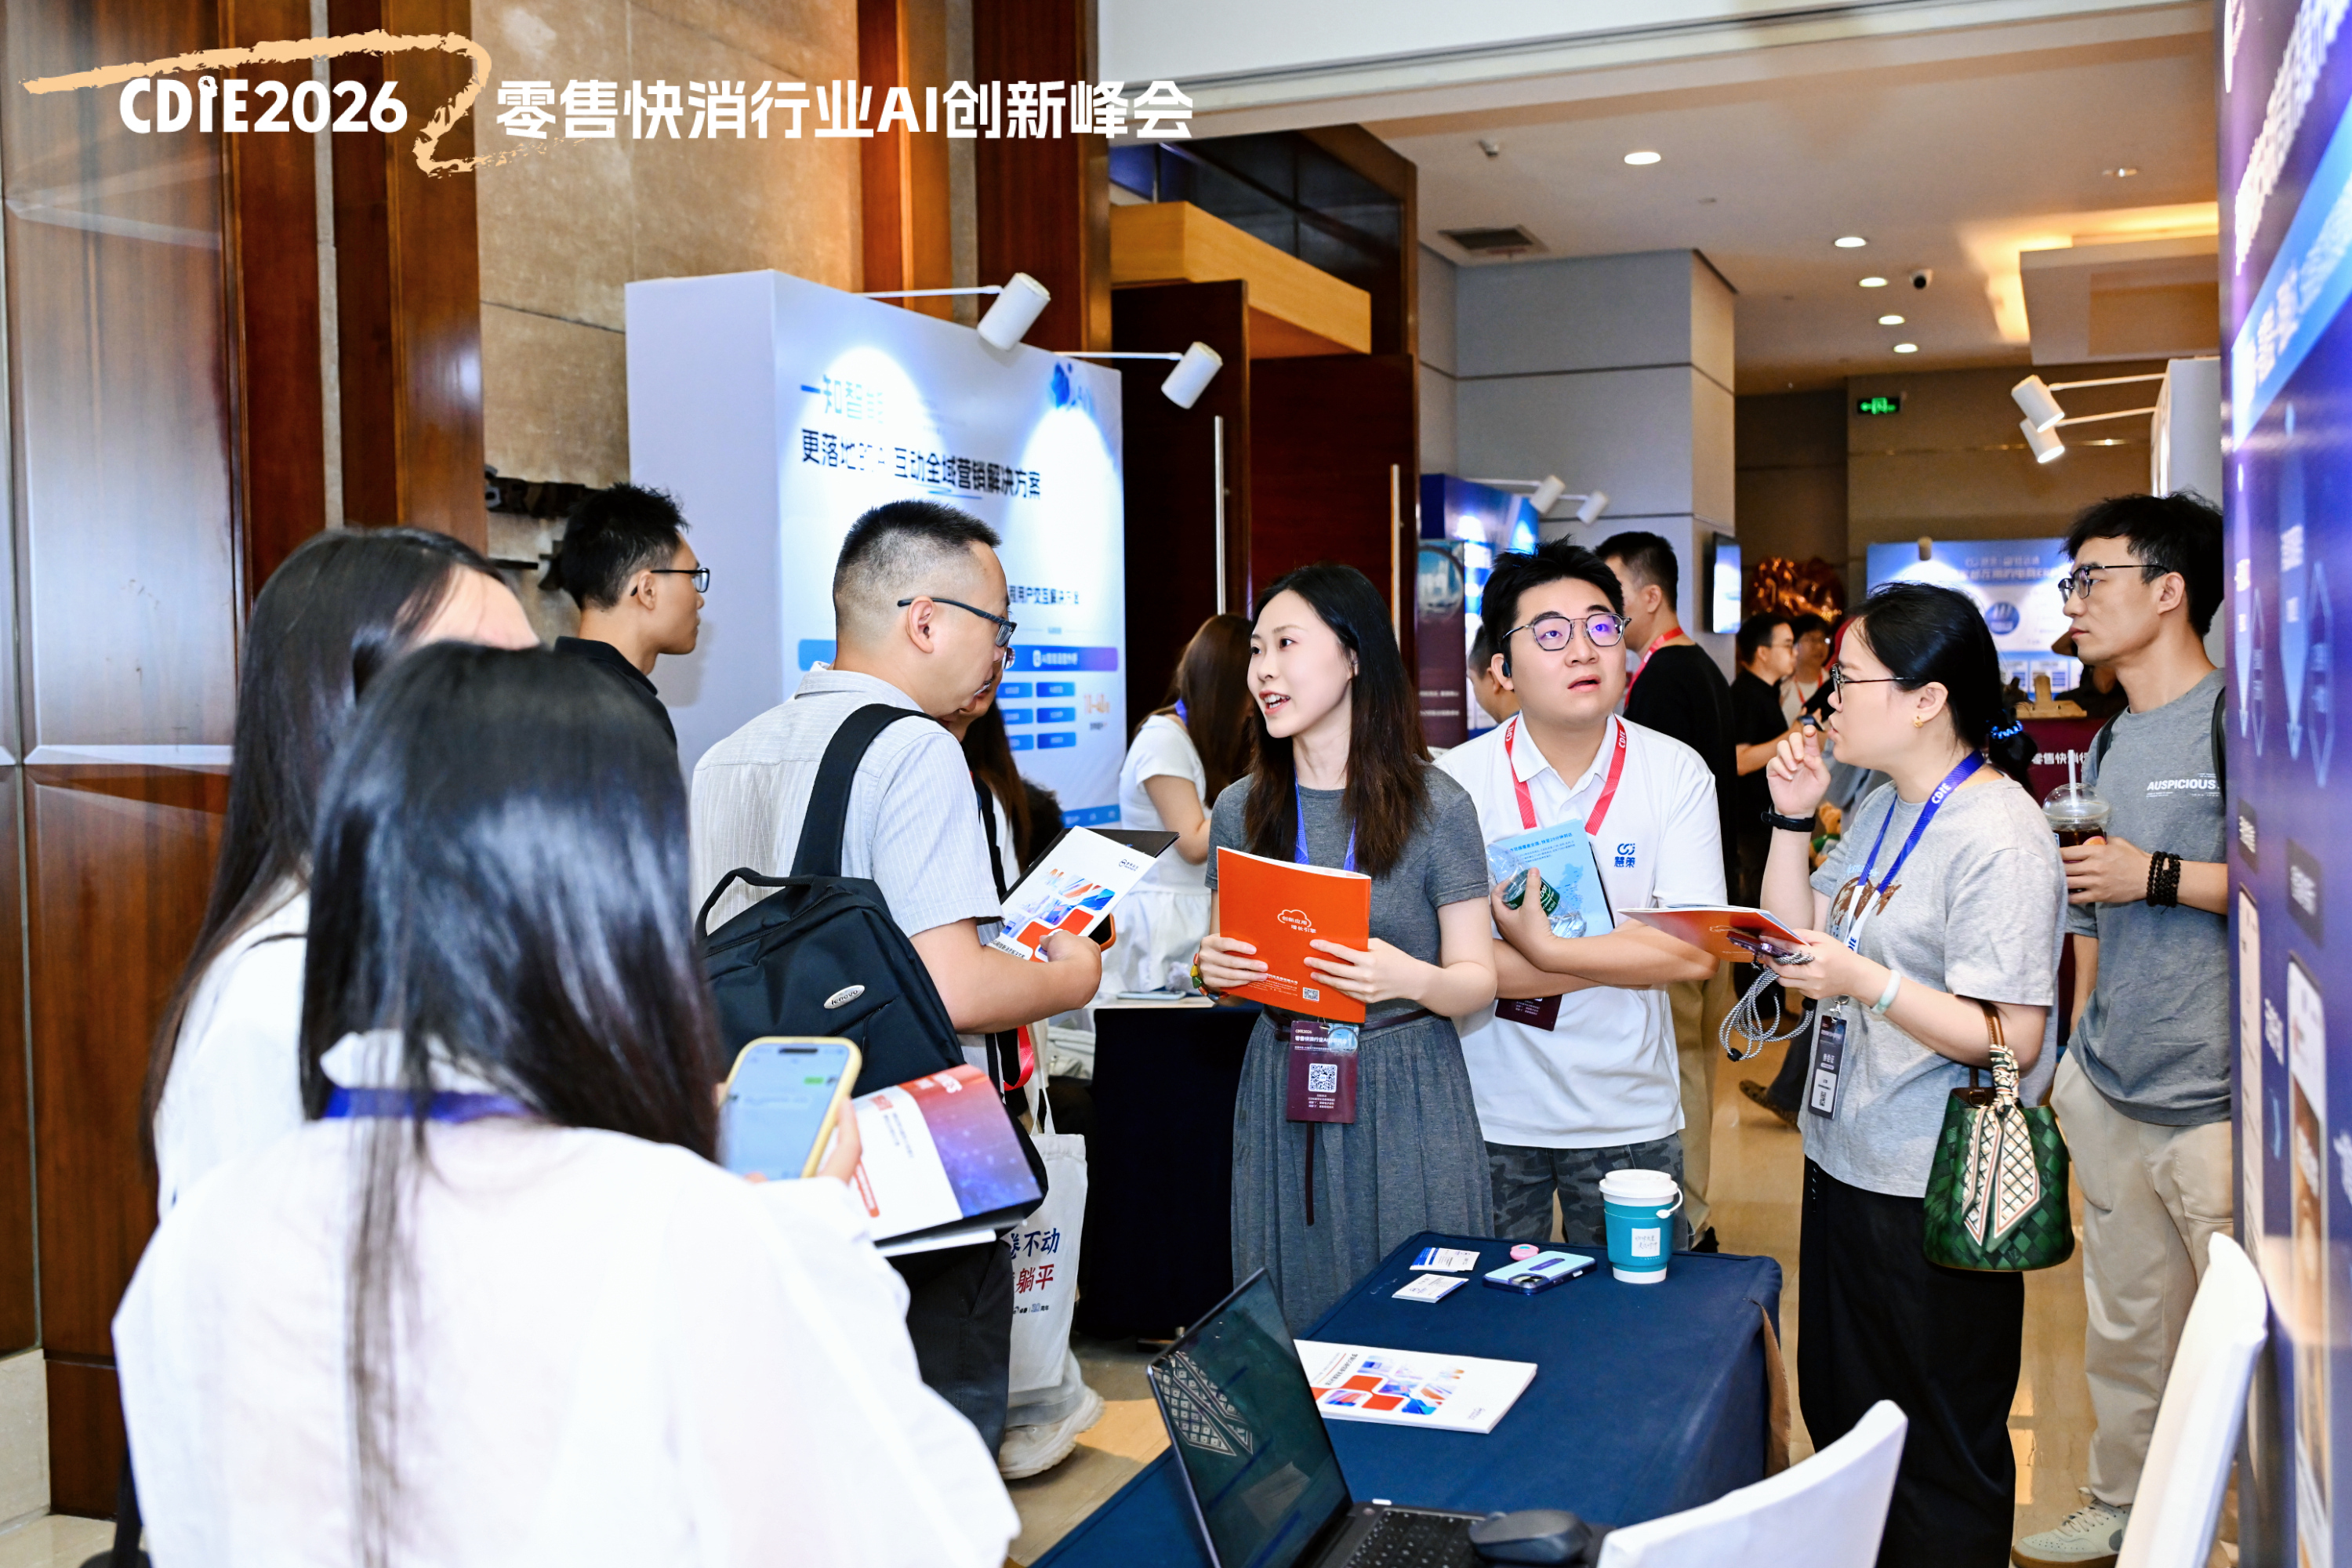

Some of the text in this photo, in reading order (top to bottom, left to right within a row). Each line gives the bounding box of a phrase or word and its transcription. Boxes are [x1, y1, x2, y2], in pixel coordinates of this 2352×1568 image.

[1931, 782, 1952, 804] CDIE
[1614, 855, 1635, 868] 慧策
[831, 990, 858, 1005] lenovo
[1012, 1263, 1054, 1294] 躺平
